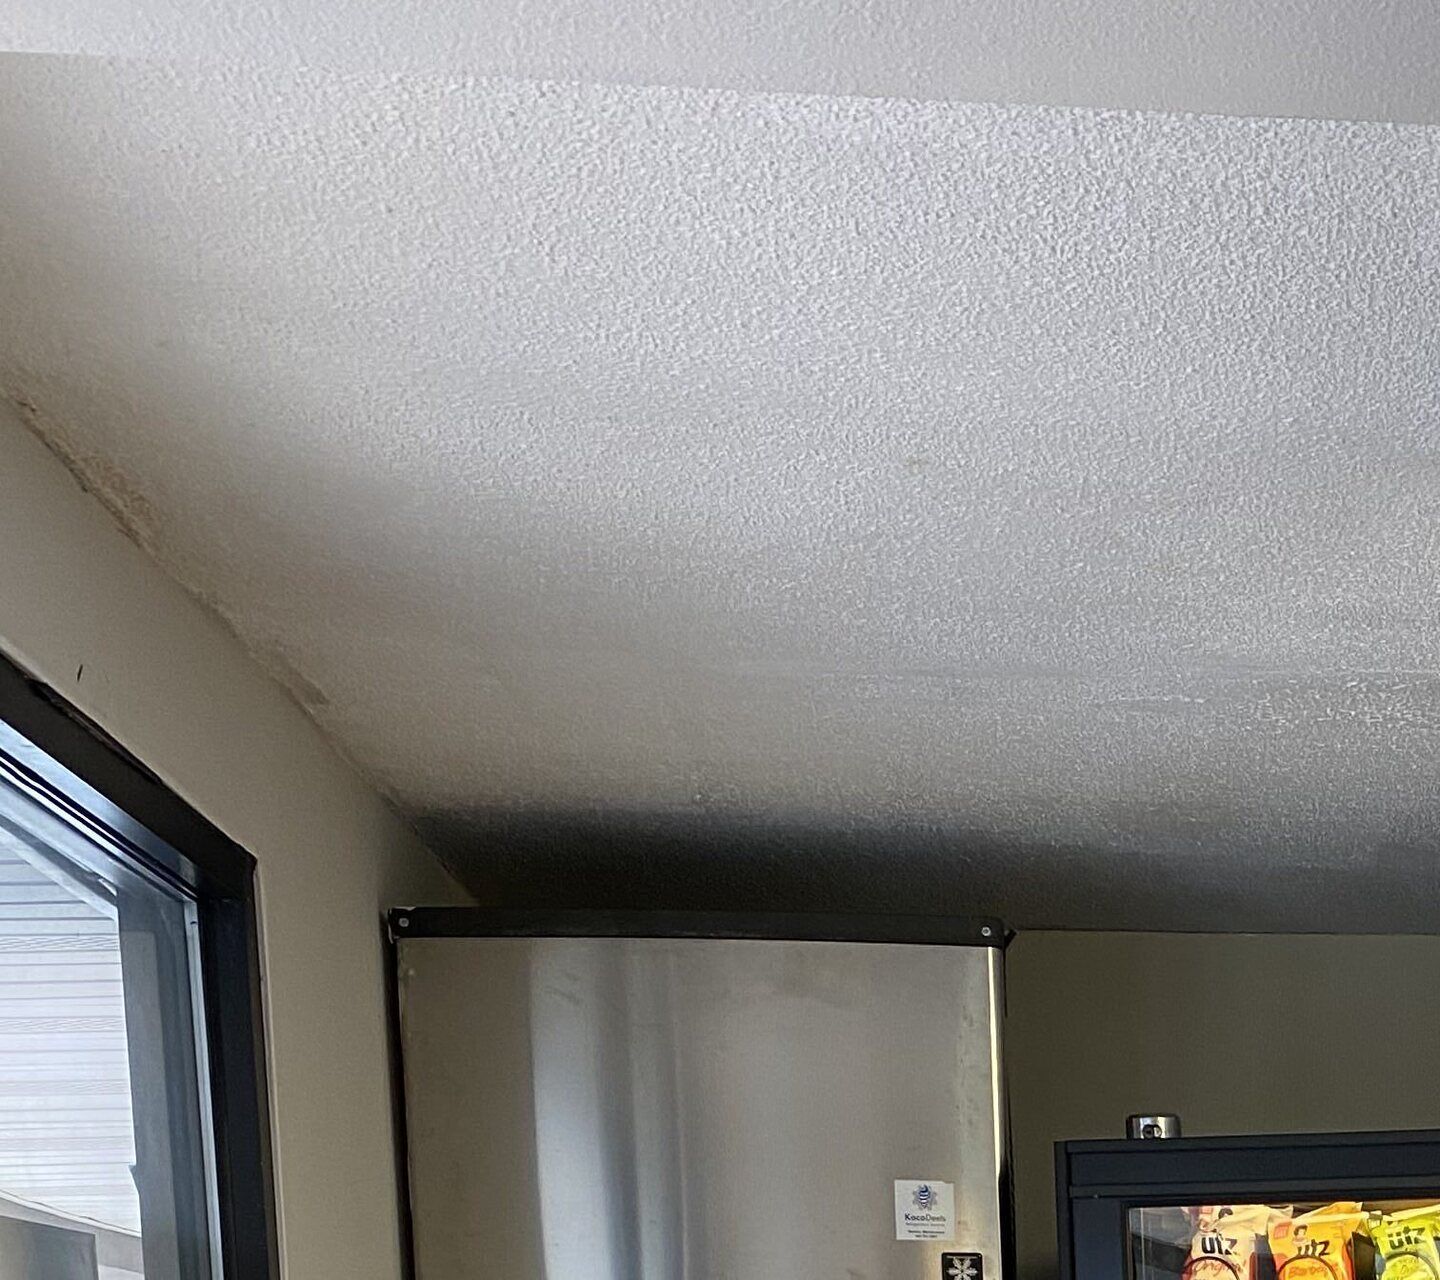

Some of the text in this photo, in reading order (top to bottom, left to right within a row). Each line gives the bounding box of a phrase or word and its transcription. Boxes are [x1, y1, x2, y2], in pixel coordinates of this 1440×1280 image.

[1201, 1233, 1238, 1256] utz
[1298, 1238, 1331, 1257] utz
[1387, 1226, 1426, 1250] utz
